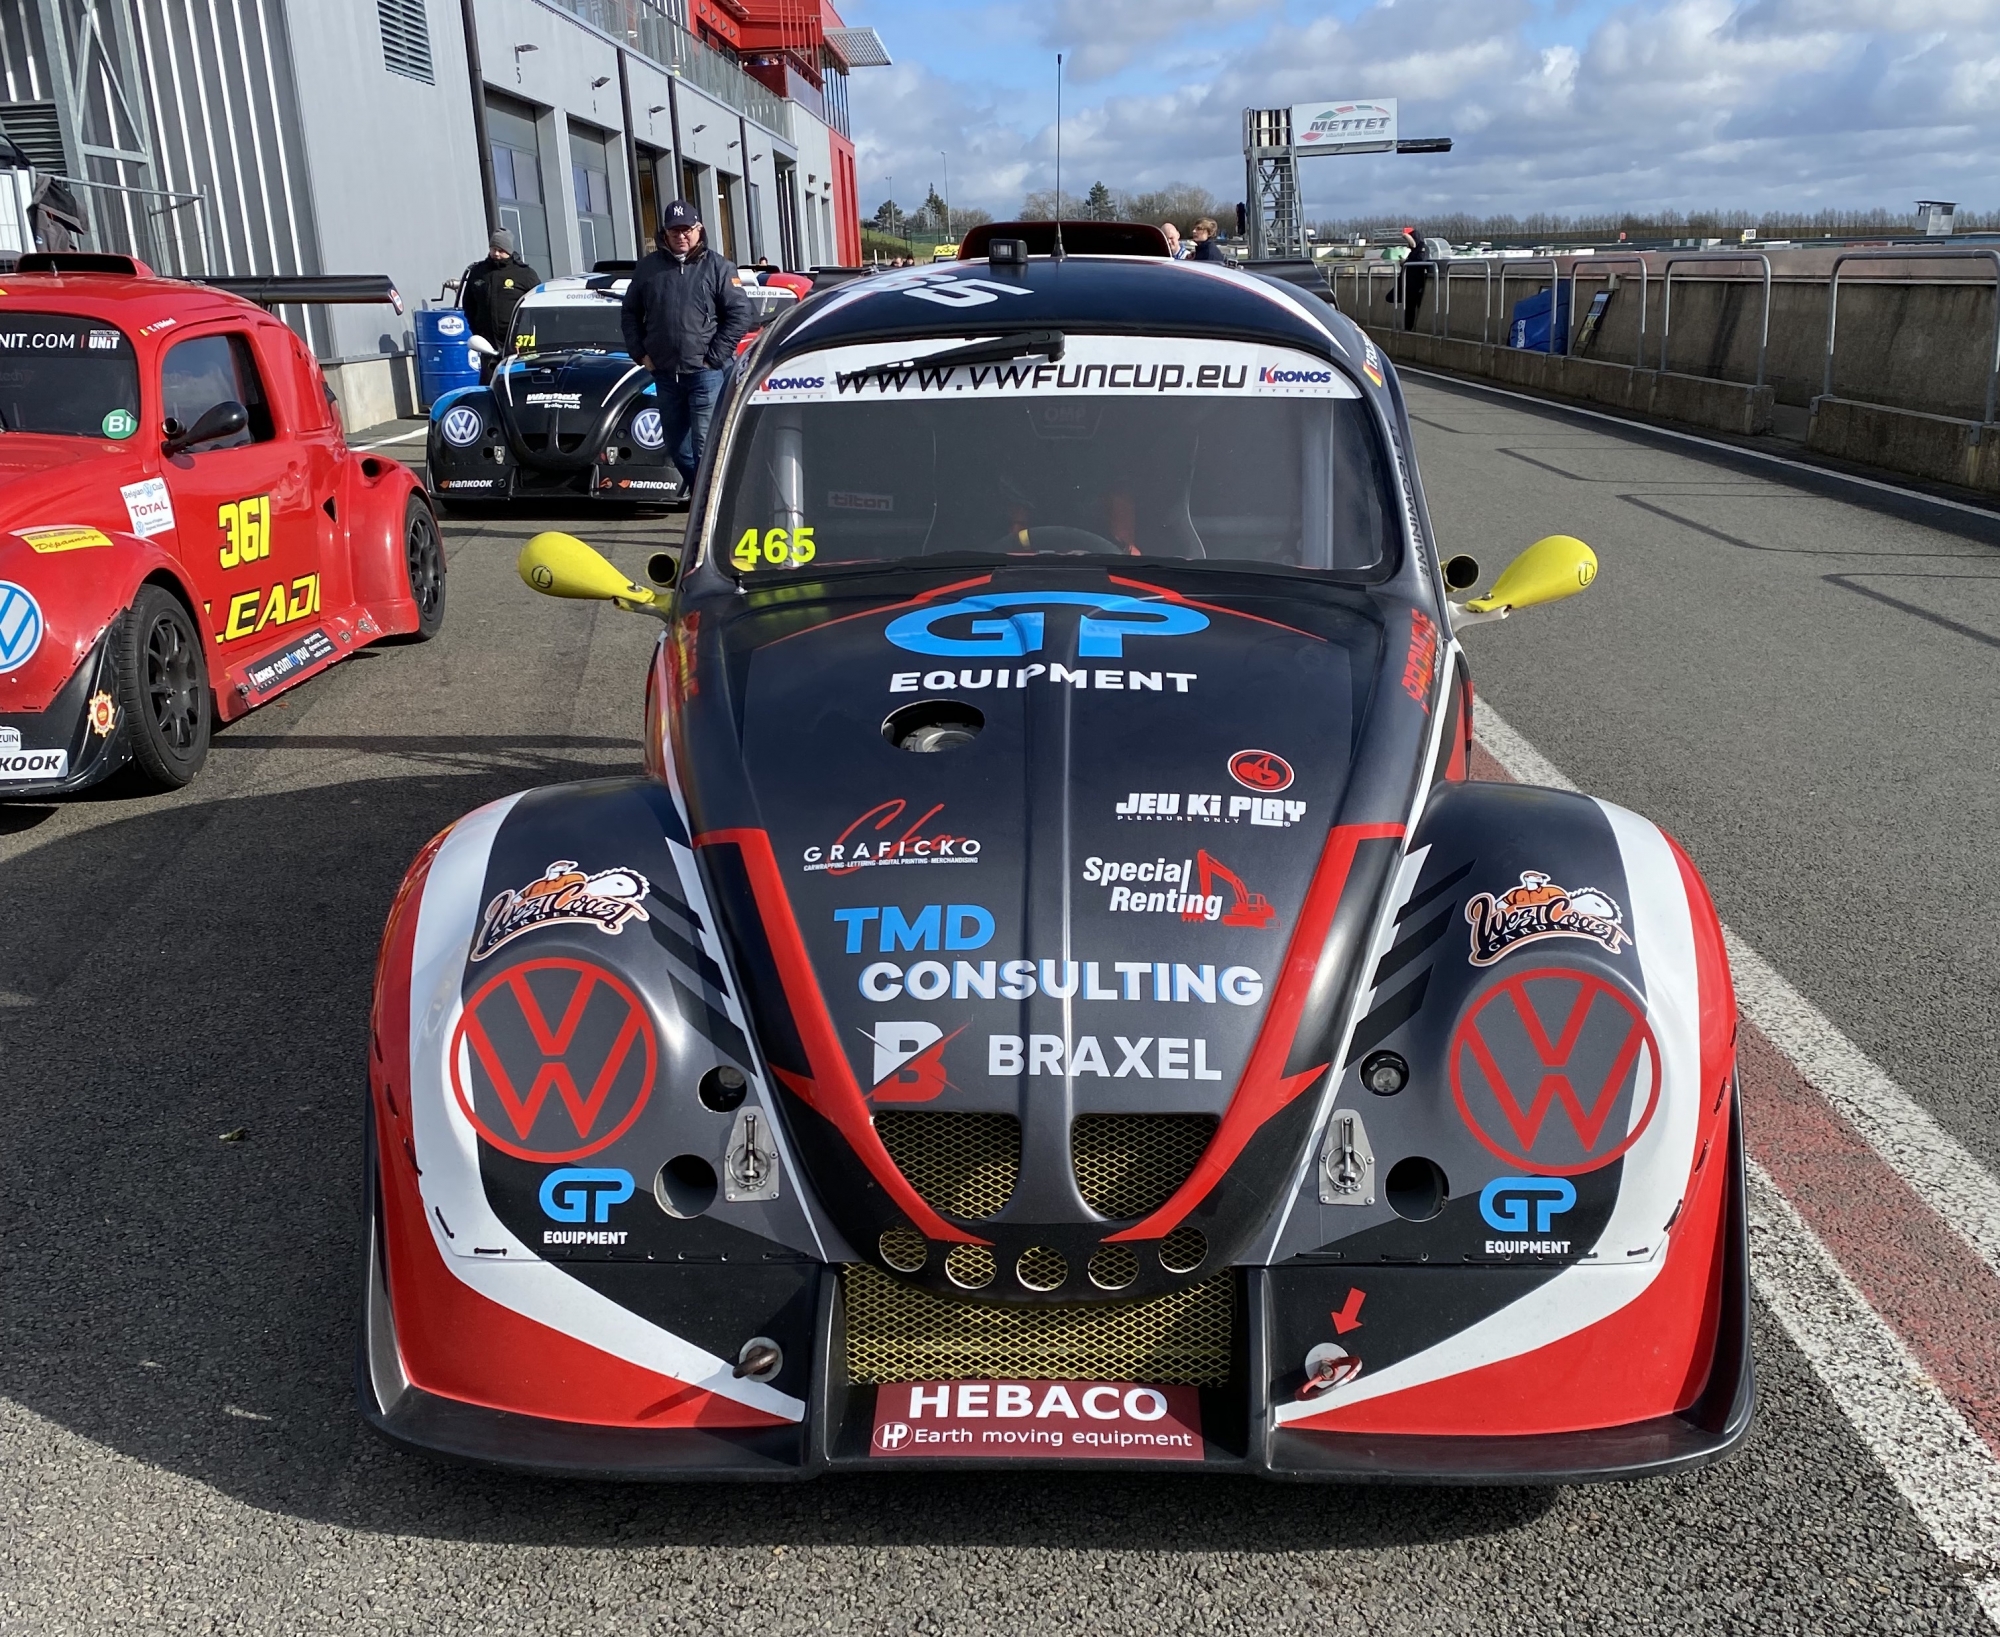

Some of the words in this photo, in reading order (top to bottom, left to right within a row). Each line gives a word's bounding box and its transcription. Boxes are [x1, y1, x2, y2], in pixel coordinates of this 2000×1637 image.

[515, 67, 521, 84] 5
[1310, 117, 1391, 132] METTET
[515, 334, 536, 347] 371
[1258, 363, 1332, 384] KRONOS
[131, 501, 168, 517] TOTAL
[218, 494, 270, 569] 361
[734, 527, 816, 564] 465
[884, 591, 1211, 658] GP
[889, 663, 1198, 693] EQUIPMENT
[1115, 793, 1180, 815] JEU
[803, 839, 982, 863] GRAFICKO
[900, 857, 928, 866] PRINTING
[930, 856, 978, 865] MERCHANDISING
[1083, 857, 1192, 893] Special
[1109, 886, 1223, 921] Renting
[833, 904, 996, 954] TMD
[858, 959, 1264, 1006] CONSULTING
[987, 1034, 1222, 1081] BRAXEL
[539, 1168, 636, 1223] GP
[1479, 1176, 1577, 1232] GP
[543, 1231, 628, 1245] EQUIPMENT
[1485, 1240, 1571, 1254] EQUIPMENT
[908, 1384, 1168, 1421] HEBACO
[882, 1424, 908, 1448] HP
[914, 1428, 973, 1443] Earth
[982, 1428, 1064, 1447] moving
[1072, 1430, 1193, 1448] equipment
